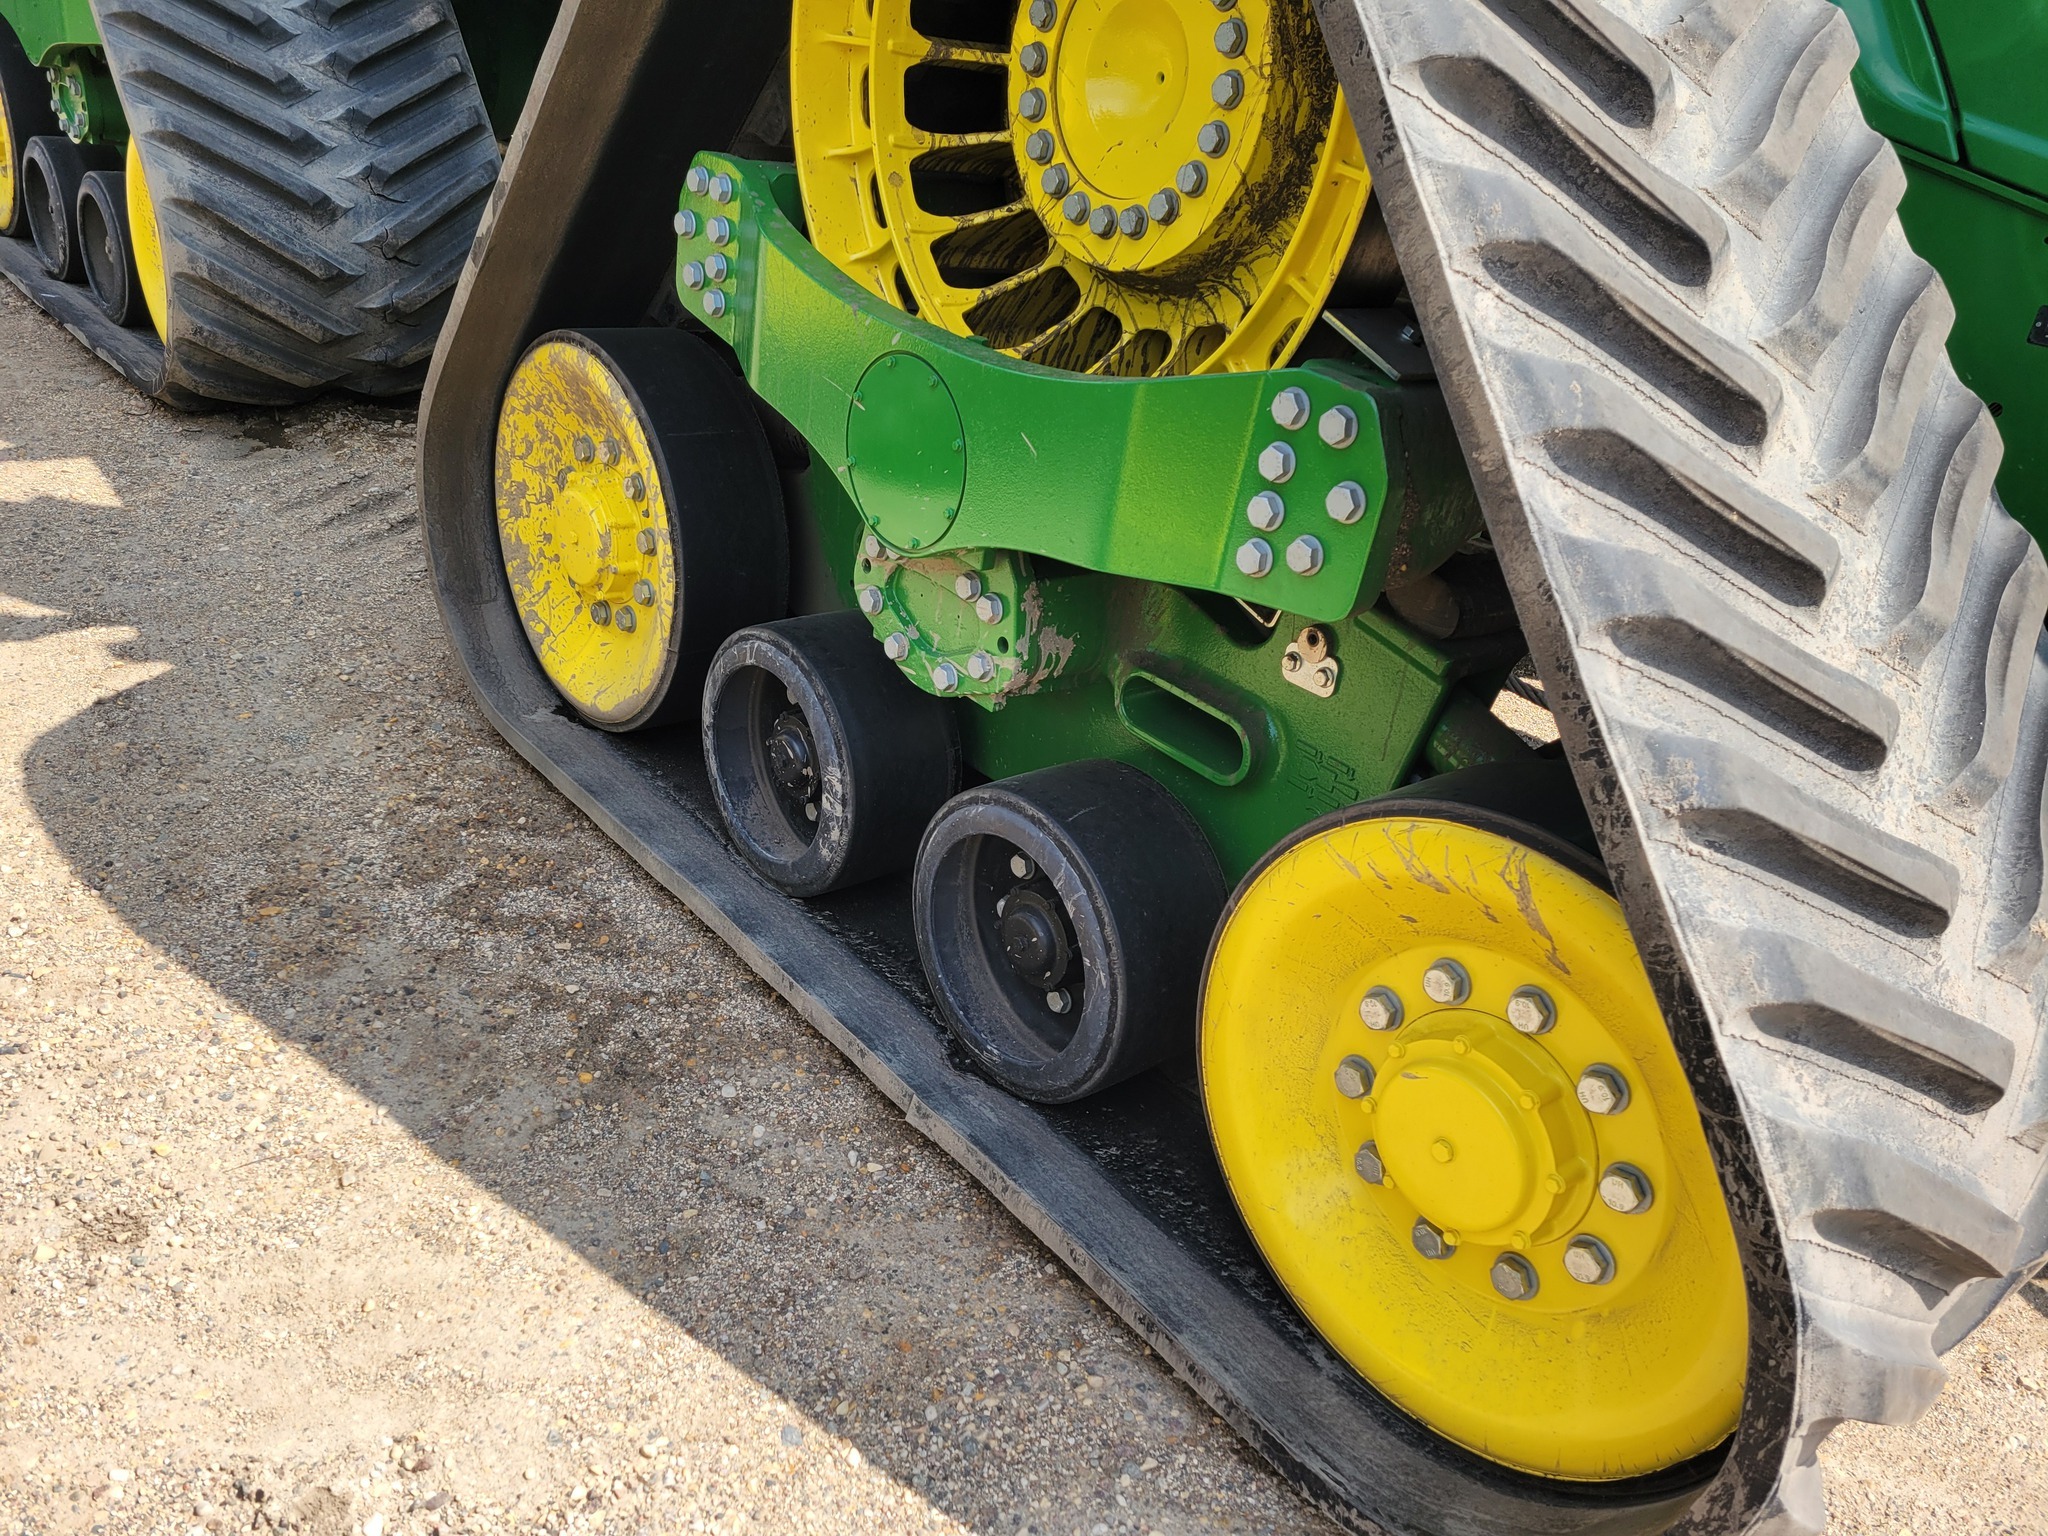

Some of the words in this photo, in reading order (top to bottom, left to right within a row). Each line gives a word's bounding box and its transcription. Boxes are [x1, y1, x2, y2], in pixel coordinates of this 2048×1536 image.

[1515, 999, 1531, 1009] 10.9
[1518, 1022, 1529, 1030] UH
[1579, 1091, 1589, 1104] UH
